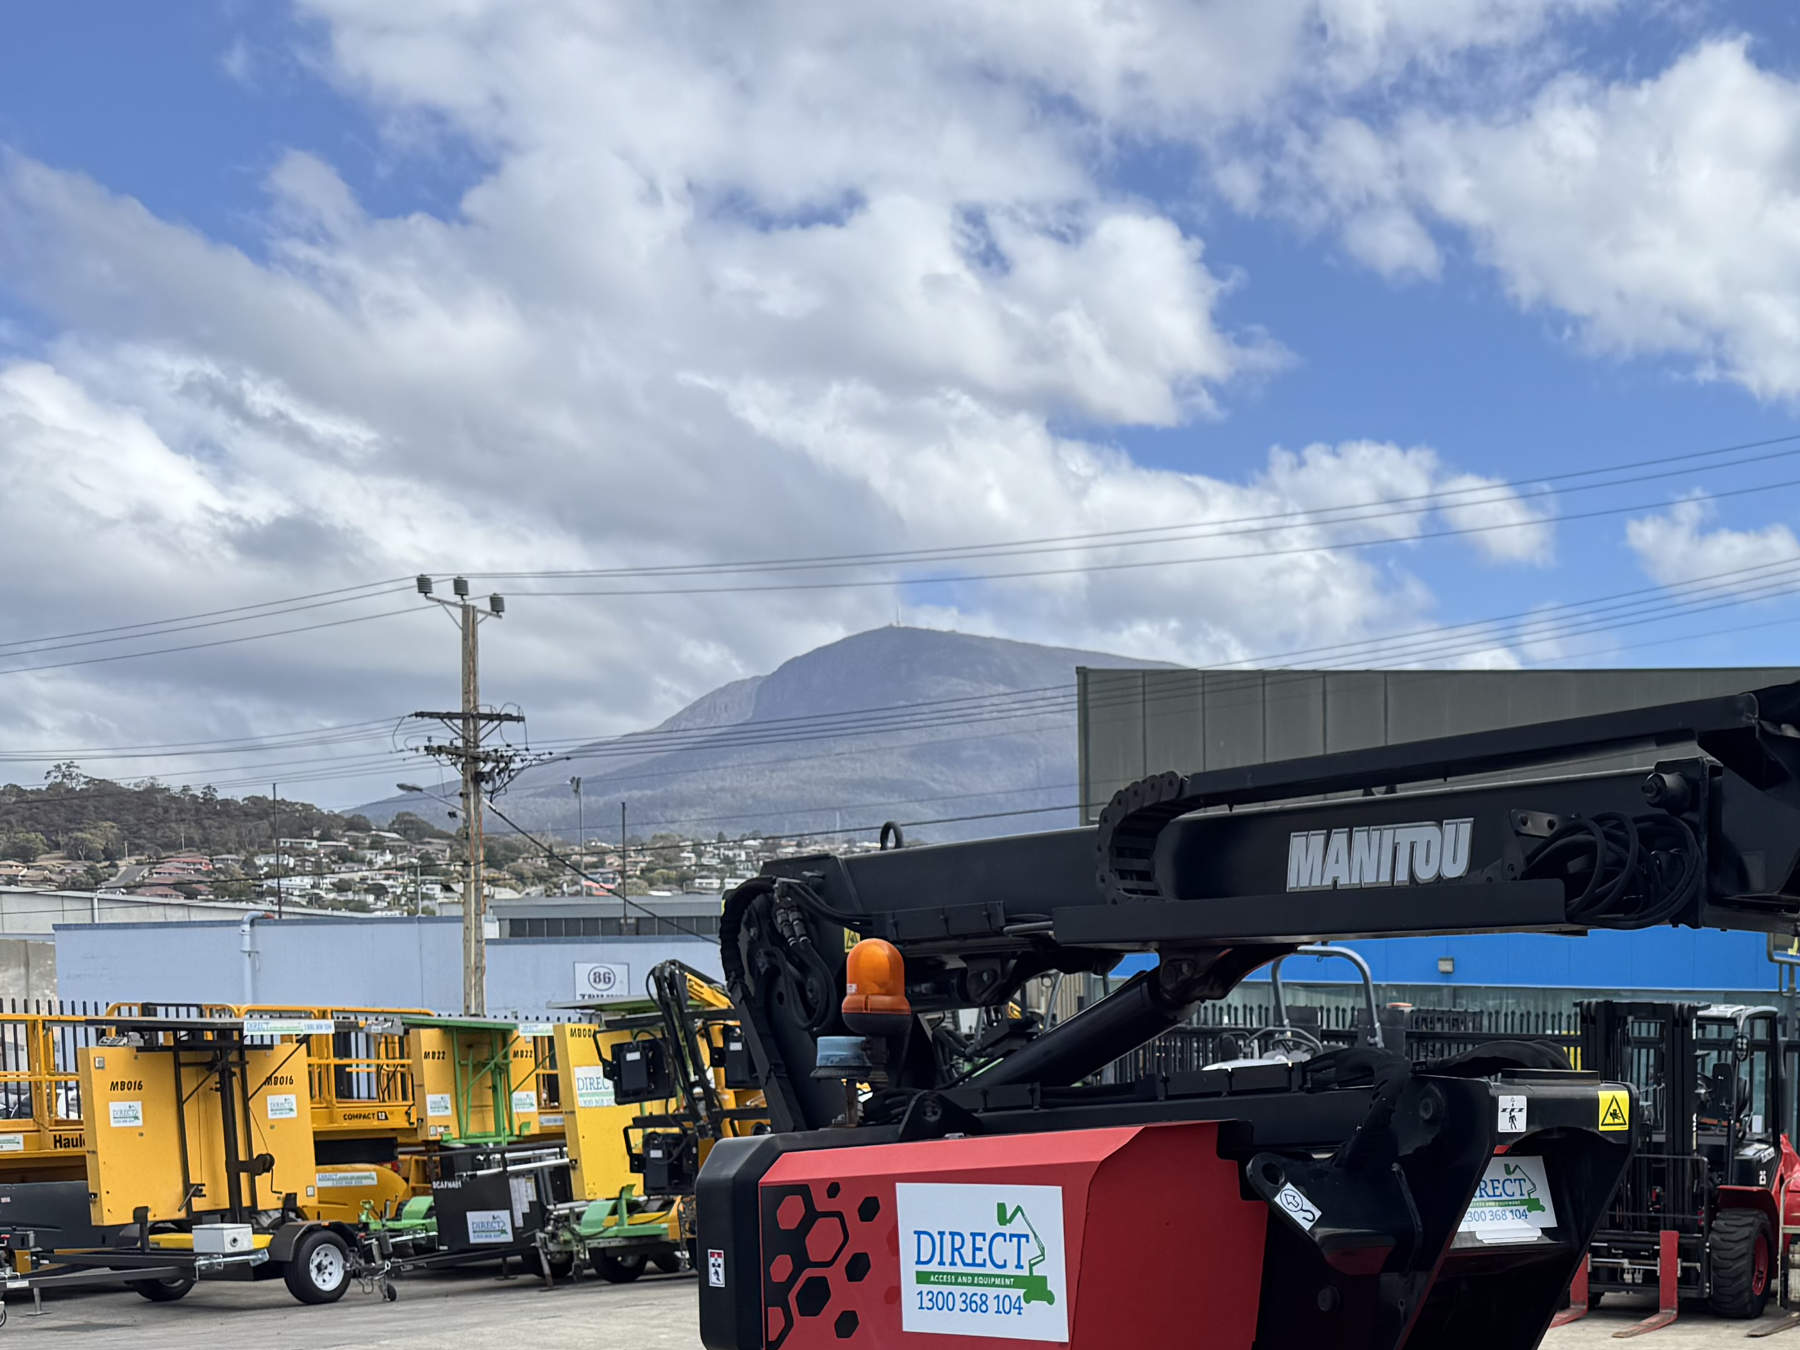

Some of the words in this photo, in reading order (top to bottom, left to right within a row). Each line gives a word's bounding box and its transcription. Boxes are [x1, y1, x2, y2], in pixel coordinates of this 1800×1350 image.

[1286, 817, 1474, 892] MANITOU
[592, 971, 613, 985] 86
[576, 1076, 611, 1091] DIREC
[343, 1112, 376, 1121] COMPACT
[1473, 1178, 1527, 1198] RECT
[1463, 1210, 1486, 1222] 300
[1487, 1209, 1508, 1222] 368
[1509, 1208, 1528, 1220] 104
[913, 1230, 1029, 1269] DIRECT
[929, 1274, 955, 1283] ACCESS
[957, 1275, 972, 1284] AND
[974, 1276, 1015, 1286] EQUIPMENT
[916, 1290, 956, 1313] 1300
[959, 1291, 989, 1314] 368
[993, 1293, 1024, 1316] 104
